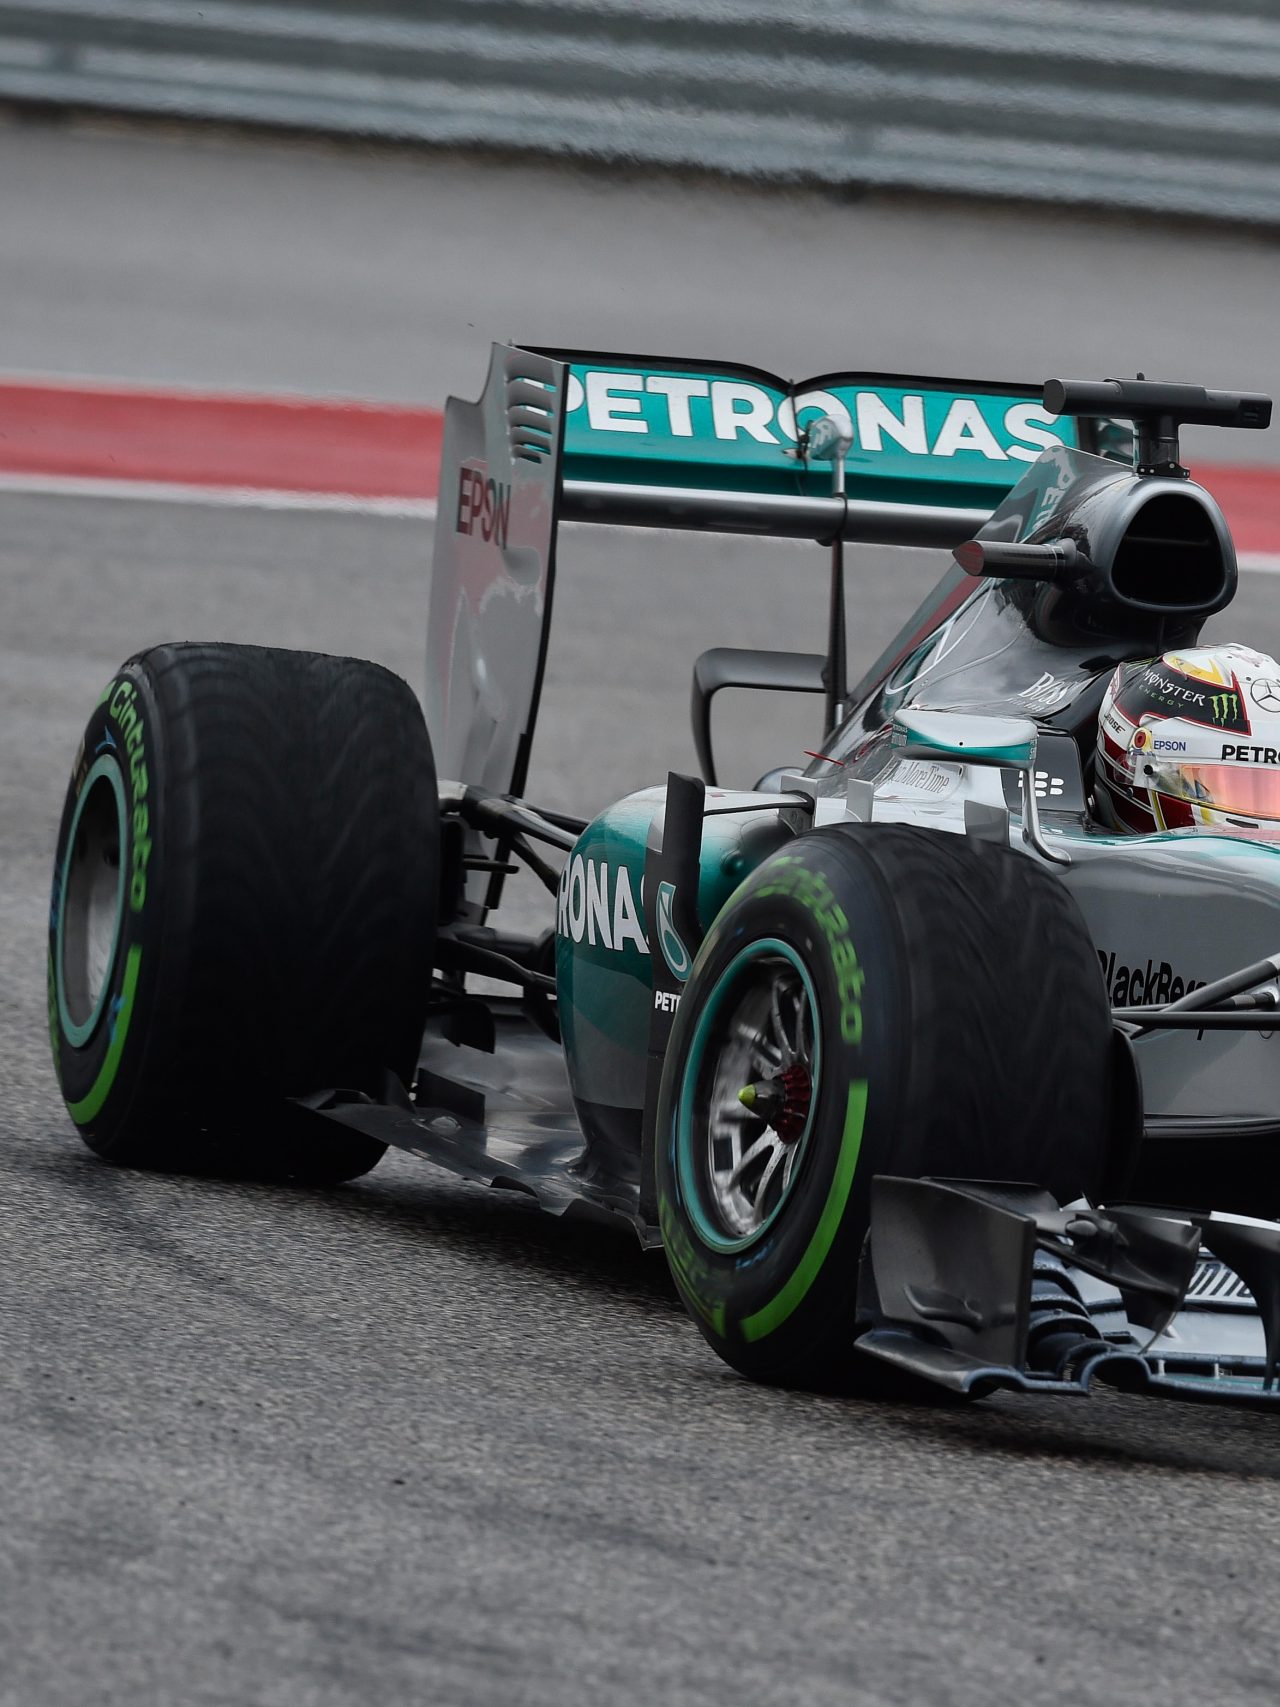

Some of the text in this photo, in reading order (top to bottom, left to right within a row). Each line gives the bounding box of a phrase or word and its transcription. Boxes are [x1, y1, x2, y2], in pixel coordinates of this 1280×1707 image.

[566, 371, 1066, 464] ETRONAS
[456, 467, 511, 550] EPSON
[1153, 740, 1187, 751] EPSON
[558, 853, 651, 954] RONA
